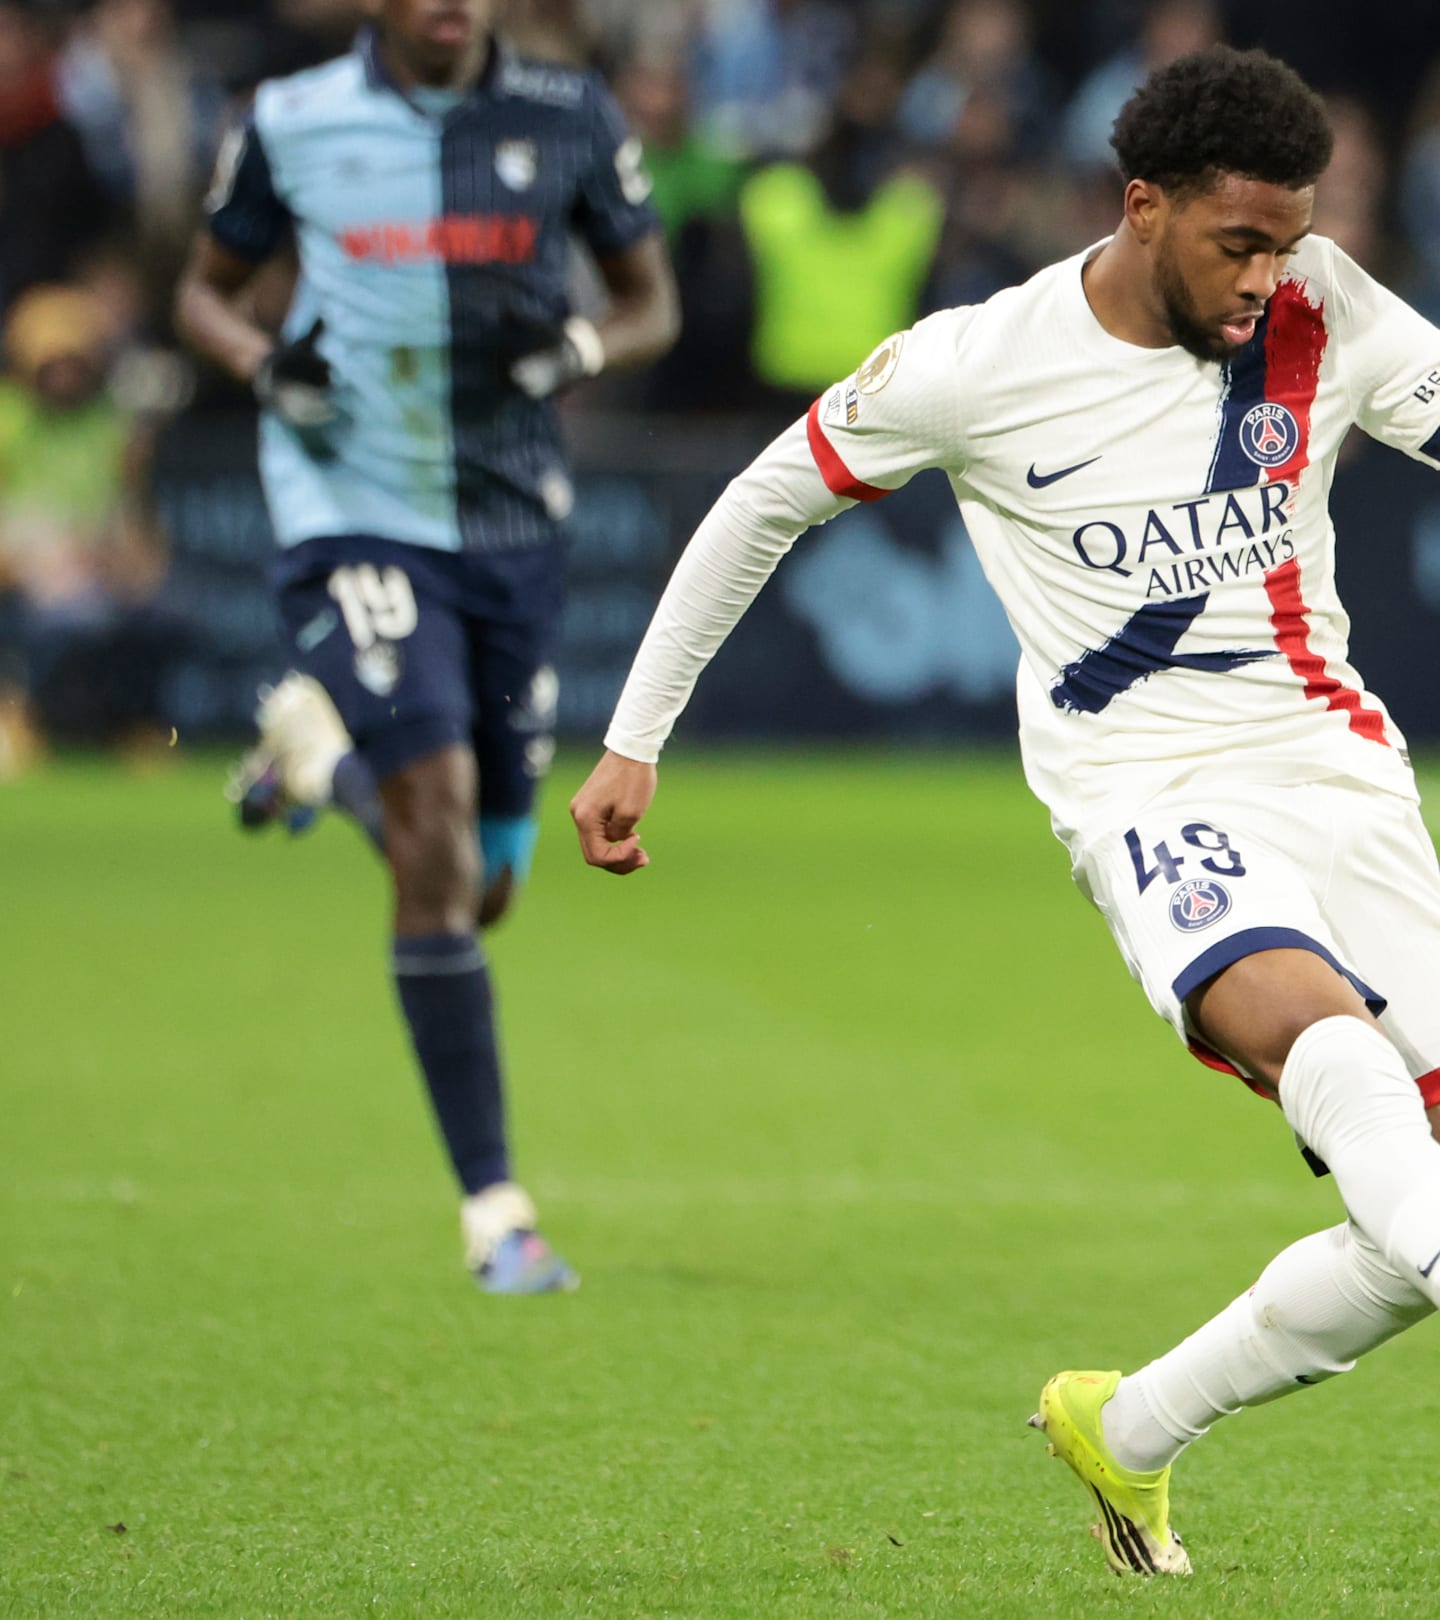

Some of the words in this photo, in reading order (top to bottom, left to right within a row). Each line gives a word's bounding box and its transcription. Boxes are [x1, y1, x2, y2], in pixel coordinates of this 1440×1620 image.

[1246, 406, 1285, 425] PARIS
[1073, 482, 1289, 577] QATAR
[1146, 529, 1294, 598] AIRWAYS
[326, 561, 418, 650] 19
[1123, 823, 1246, 896] 49
[1173, 881, 1210, 905] PARIS
